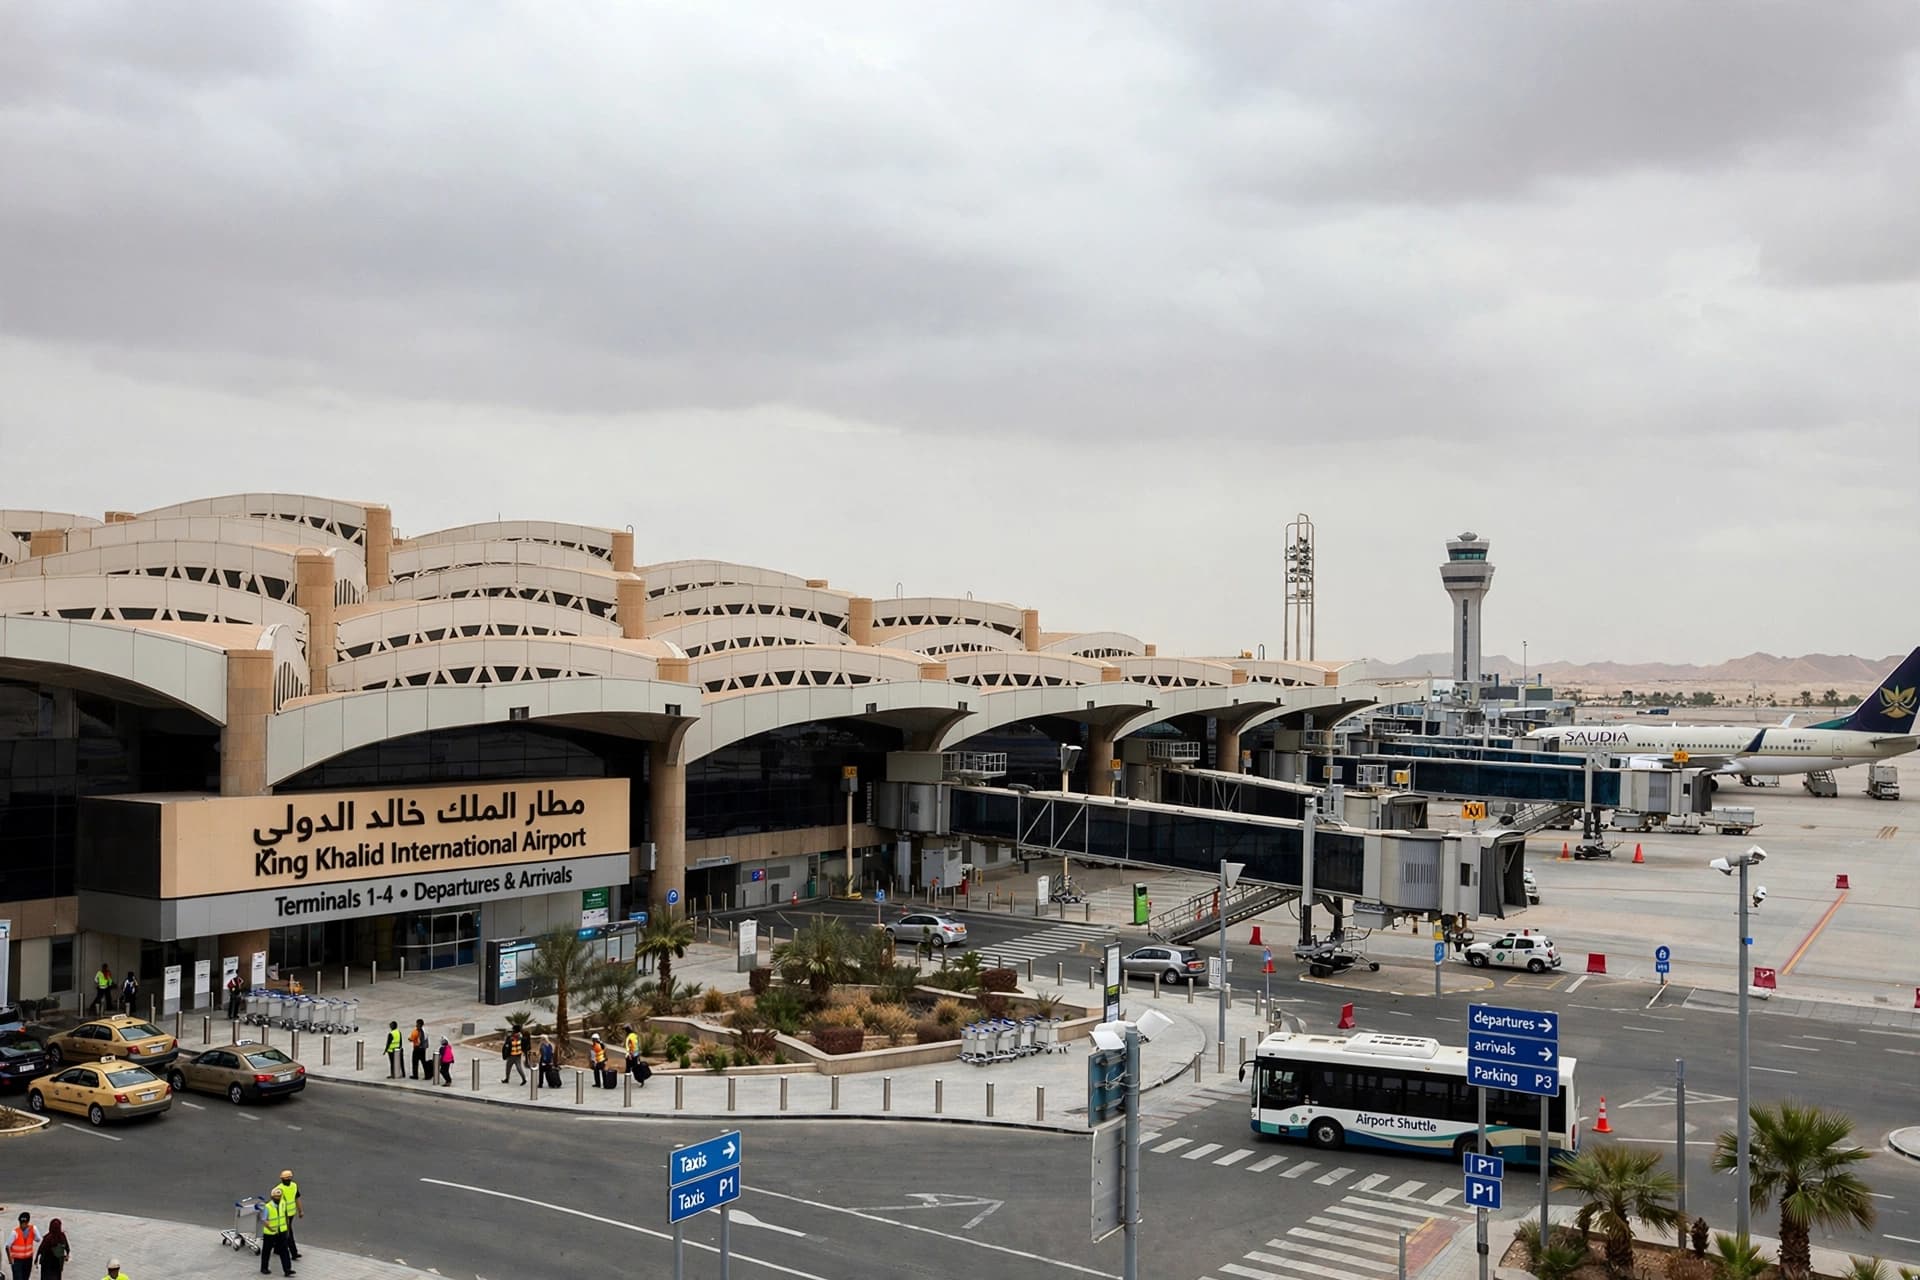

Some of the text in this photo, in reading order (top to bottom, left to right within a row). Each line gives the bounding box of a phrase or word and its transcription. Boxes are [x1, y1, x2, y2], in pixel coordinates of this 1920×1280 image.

[1565, 731, 1629, 744] SAUDIA
[366, 798, 425, 829] خالد
[437, 791, 516, 824] الملك
[526, 790, 585, 825] مطار
[255, 828, 587, 880] King Khalid International Airport
[275, 889, 361, 916] Terminals
[367, 885, 393, 906] 1-4
[414, 876, 500, 903] Departures
[504, 872, 516, 890] &
[519, 866, 573, 888] Arrivals
[1474, 1010, 1535, 1030] departures
[1474, 1040, 1516, 1056] arrivals
[1474, 1066, 1552, 1089] Parking P3
[1356, 1113, 1436, 1132] Airport Shuttle
[680, 1151, 707, 1173] Taxis
[1478, 1158, 1494, 1175] P1
[678, 1176, 734, 1210] Taxis P1
[1472, 1182, 1493, 1202] P1
